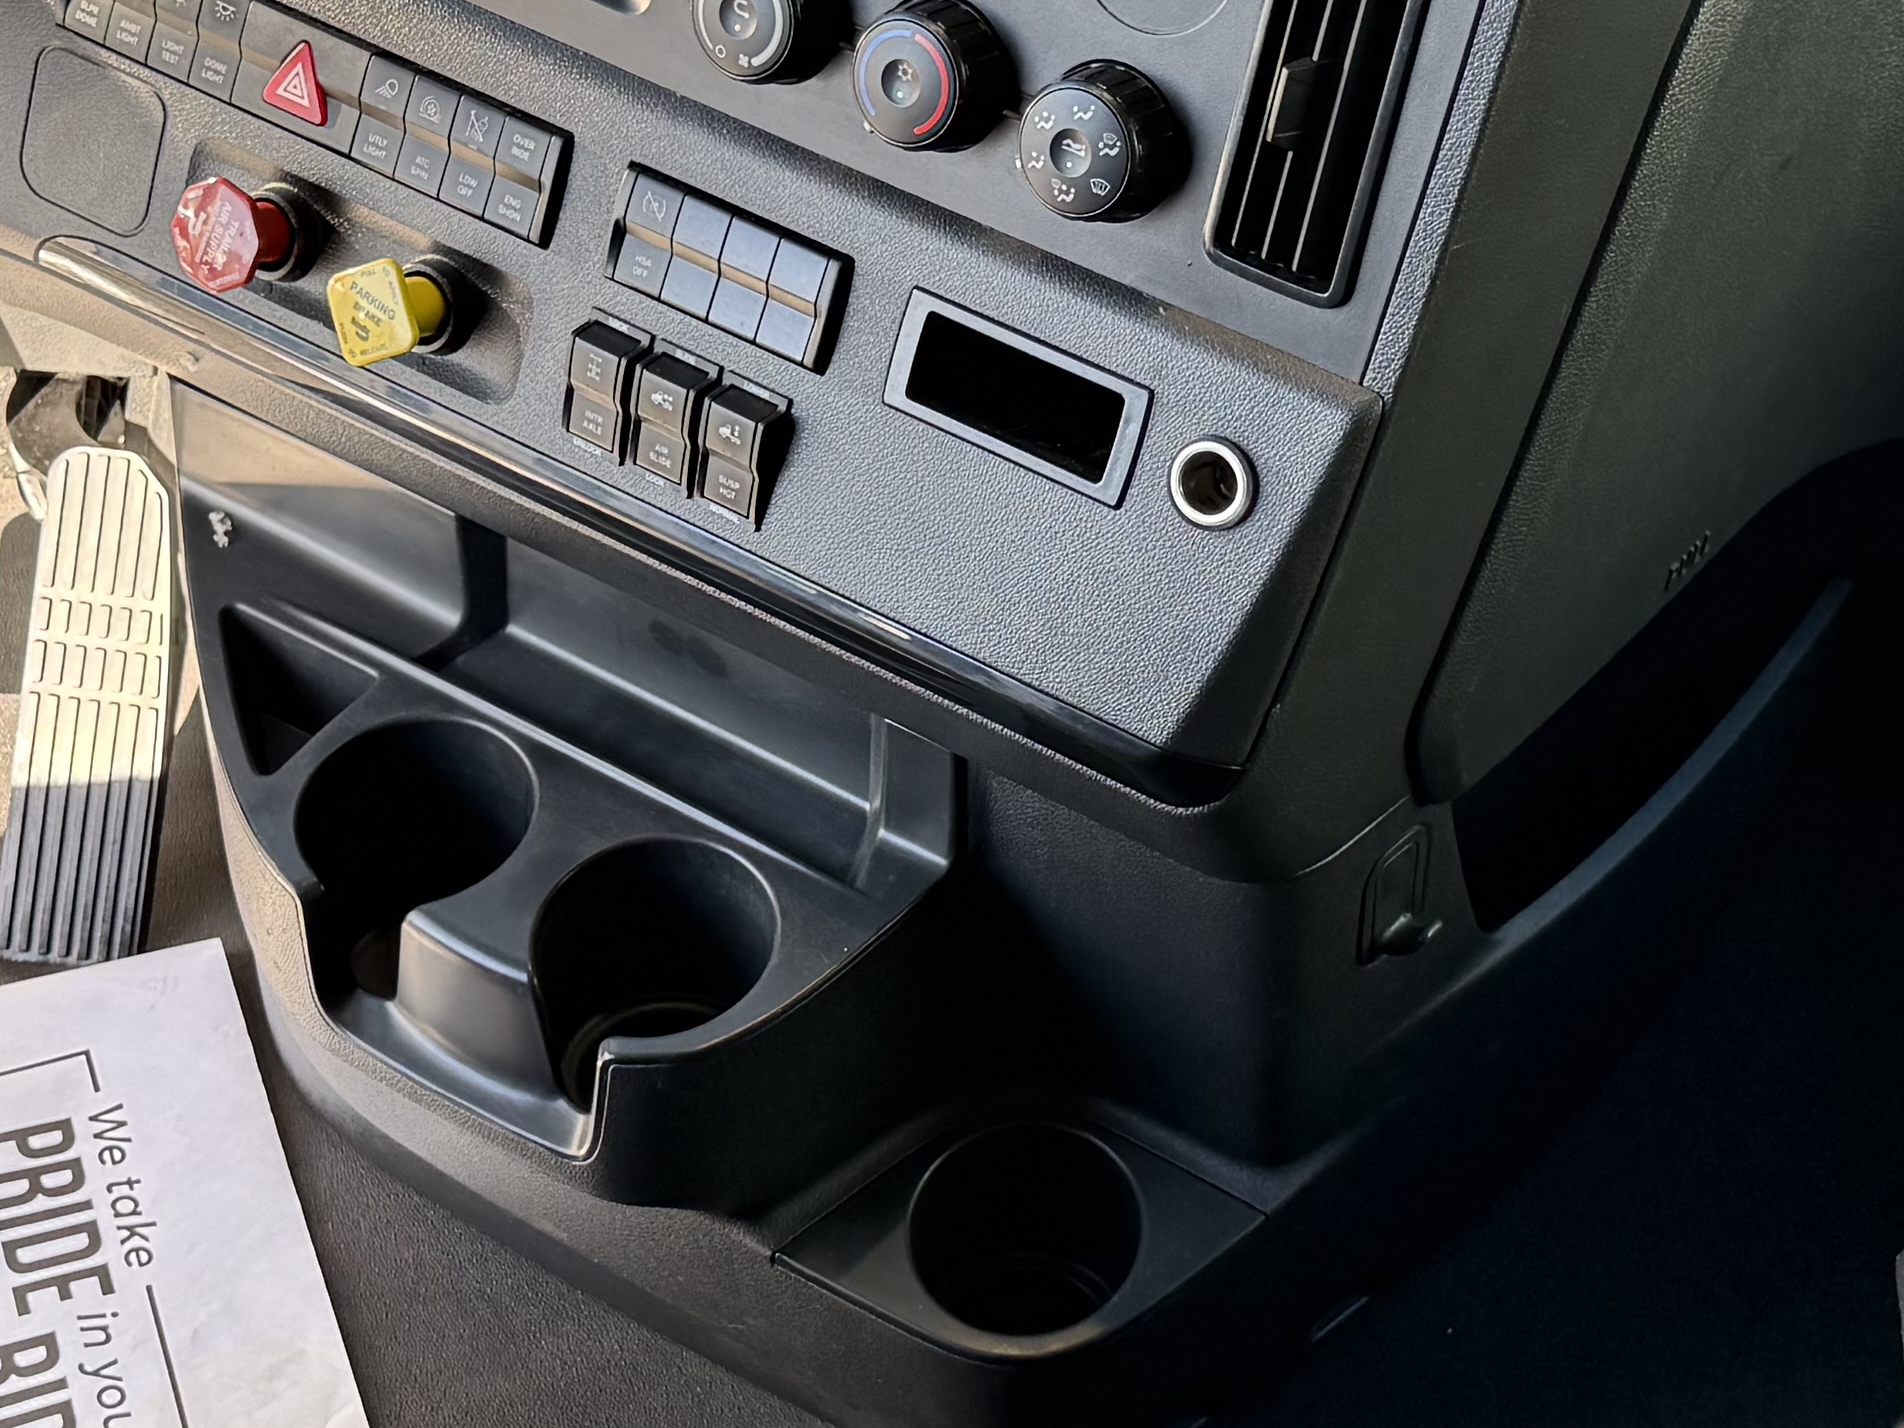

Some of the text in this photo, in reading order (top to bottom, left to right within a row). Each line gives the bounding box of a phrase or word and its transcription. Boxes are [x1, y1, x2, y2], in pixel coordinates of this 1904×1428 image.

[116, 30, 138, 46] LIGHT
[162, 40, 184, 55] LIGHT
[162, 50, 179, 64] TEST
[204, 57, 228, 74] DOME
[201, 69, 224, 84] LIGHT
[368, 133, 388, 147] UTLY
[513, 134, 536, 150] OVER
[363, 144, 387, 159] LIGHT
[511, 147, 529, 162] RIDE
[459, 173, 478, 188] LOW
[457, 185, 473, 197] OFF
[504, 194, 522, 209] ENG
[217, 201, 232, 224] AIR
[201, 225, 223, 274] SUPPLY
[350, 279, 395, 320] PARKING
[718, 475, 740, 490] SUSP
[88, 1102, 157, 1268] We take
[76, 1311, 120, 1349] in
